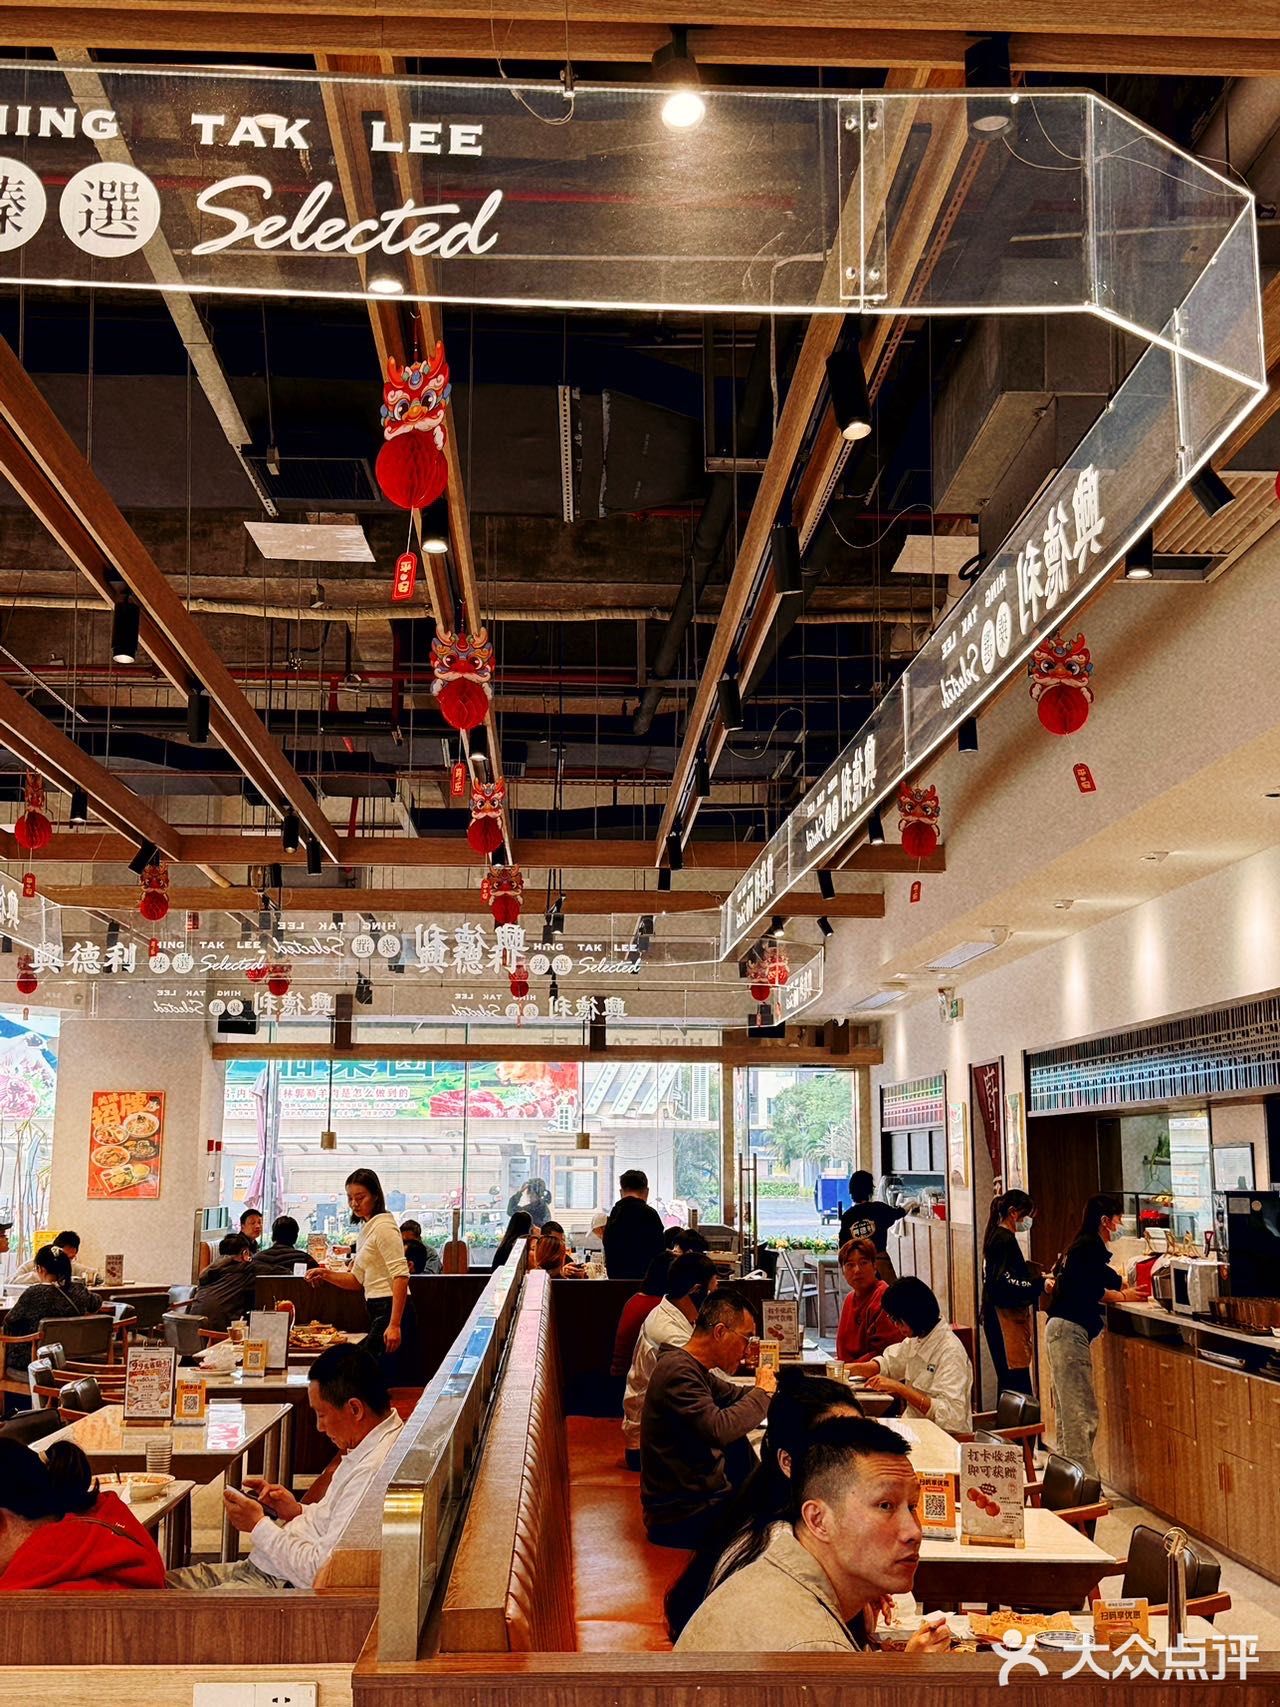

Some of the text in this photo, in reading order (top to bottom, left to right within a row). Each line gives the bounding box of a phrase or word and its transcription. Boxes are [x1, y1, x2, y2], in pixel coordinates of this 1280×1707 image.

[191, 113, 311, 150] TAK
[371, 121, 484, 156] LEE
[192, 174, 503, 259] Selected
[199, 941, 225, 949] TAK
[236, 941, 262, 949] LEE
[577, 944, 602, 952] TAK
[613, 944, 639, 952] LEE
[199, 954, 266, 973] Selected
[577, 956, 642, 975] Selected
[1100, 1610, 1141, 1621] 扫码享优惠
